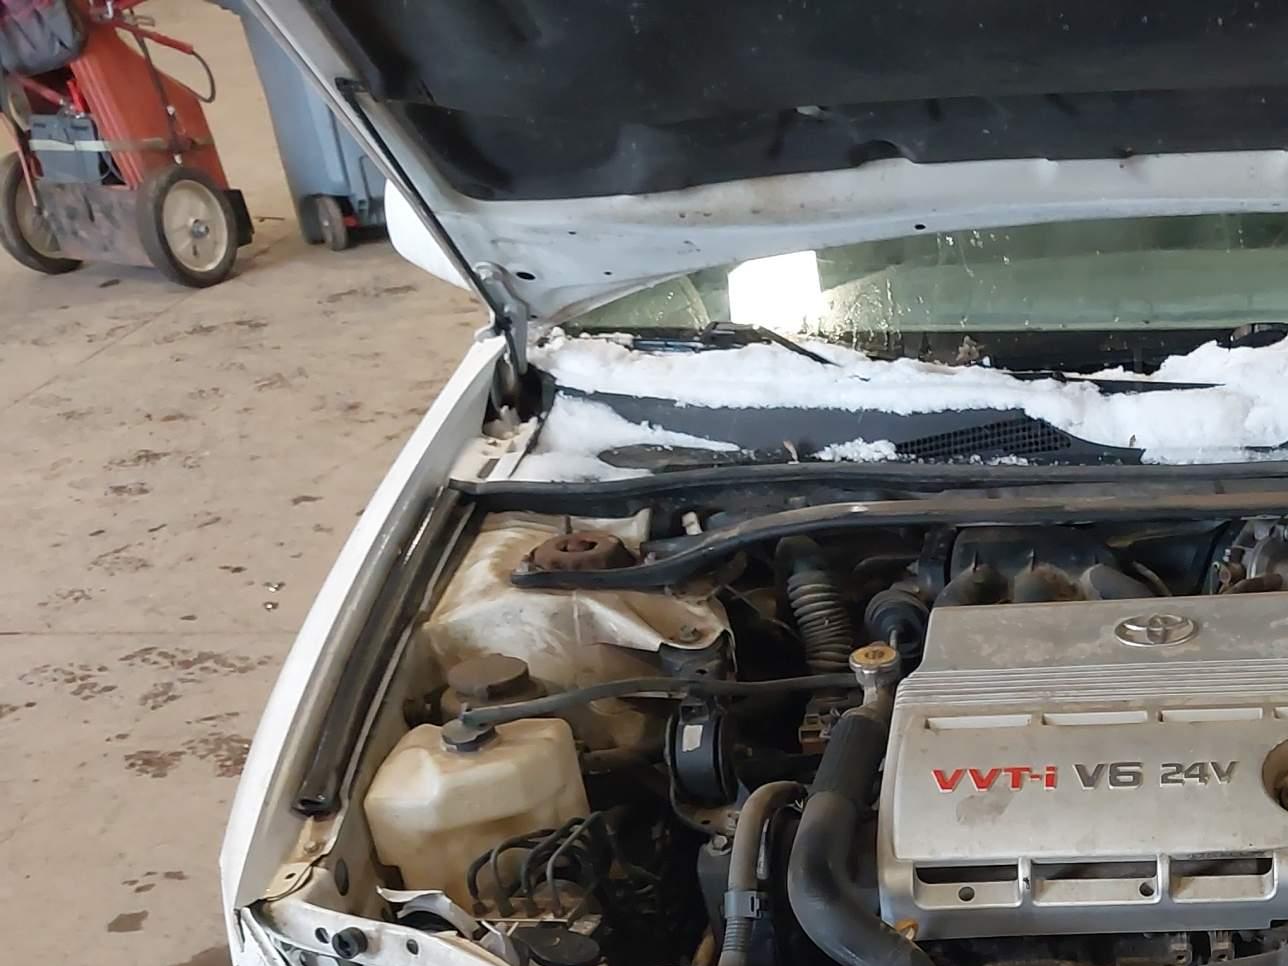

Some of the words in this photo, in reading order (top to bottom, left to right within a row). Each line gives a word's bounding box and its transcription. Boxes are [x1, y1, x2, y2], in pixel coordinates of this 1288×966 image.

[932, 765, 1058, 793] VVT-i
[1073, 761, 1143, 790] V6
[1159, 760, 1239, 788] 24V
